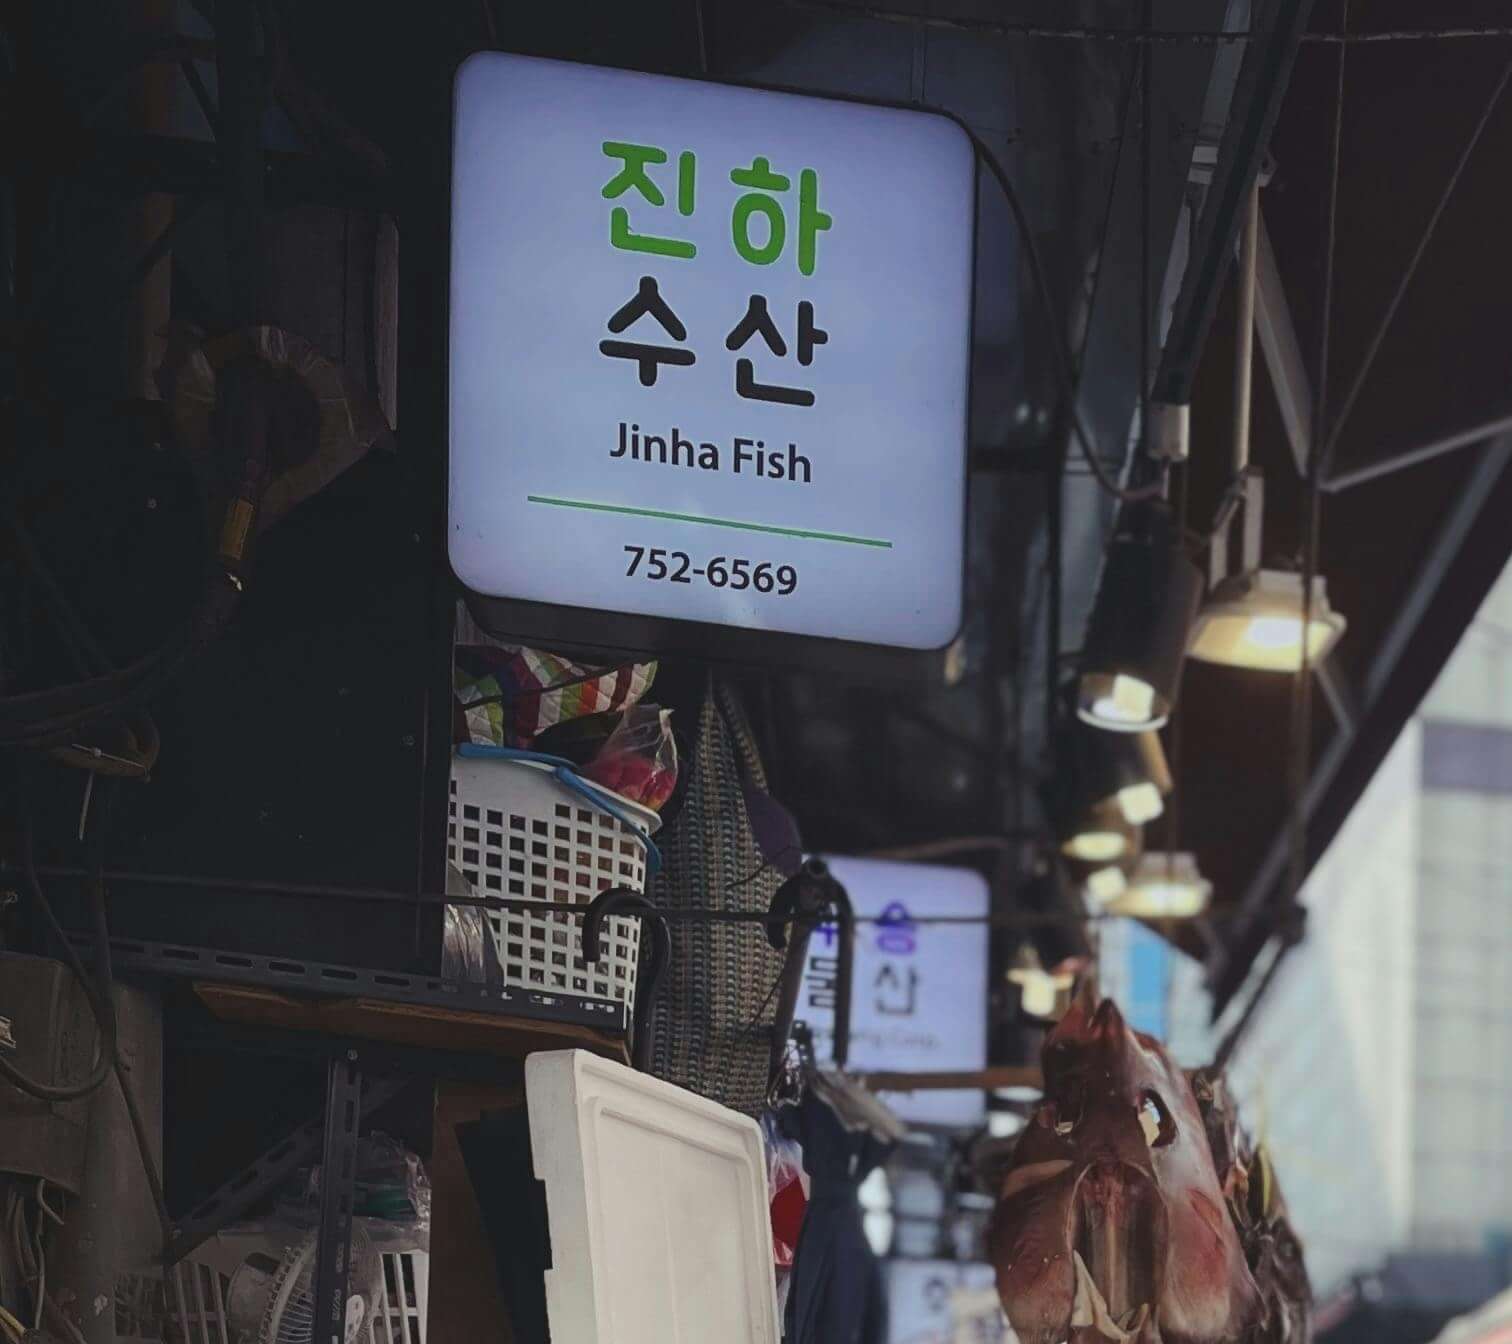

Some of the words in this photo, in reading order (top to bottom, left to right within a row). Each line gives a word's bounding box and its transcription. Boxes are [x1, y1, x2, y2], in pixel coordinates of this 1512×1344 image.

[601, 141, 833, 277] 진하
[599, 276, 829, 407] 수산
[610, 423, 719, 471] Jinha
[733, 438, 812, 483] Fish
[624, 545, 798, 596] 752-6569
